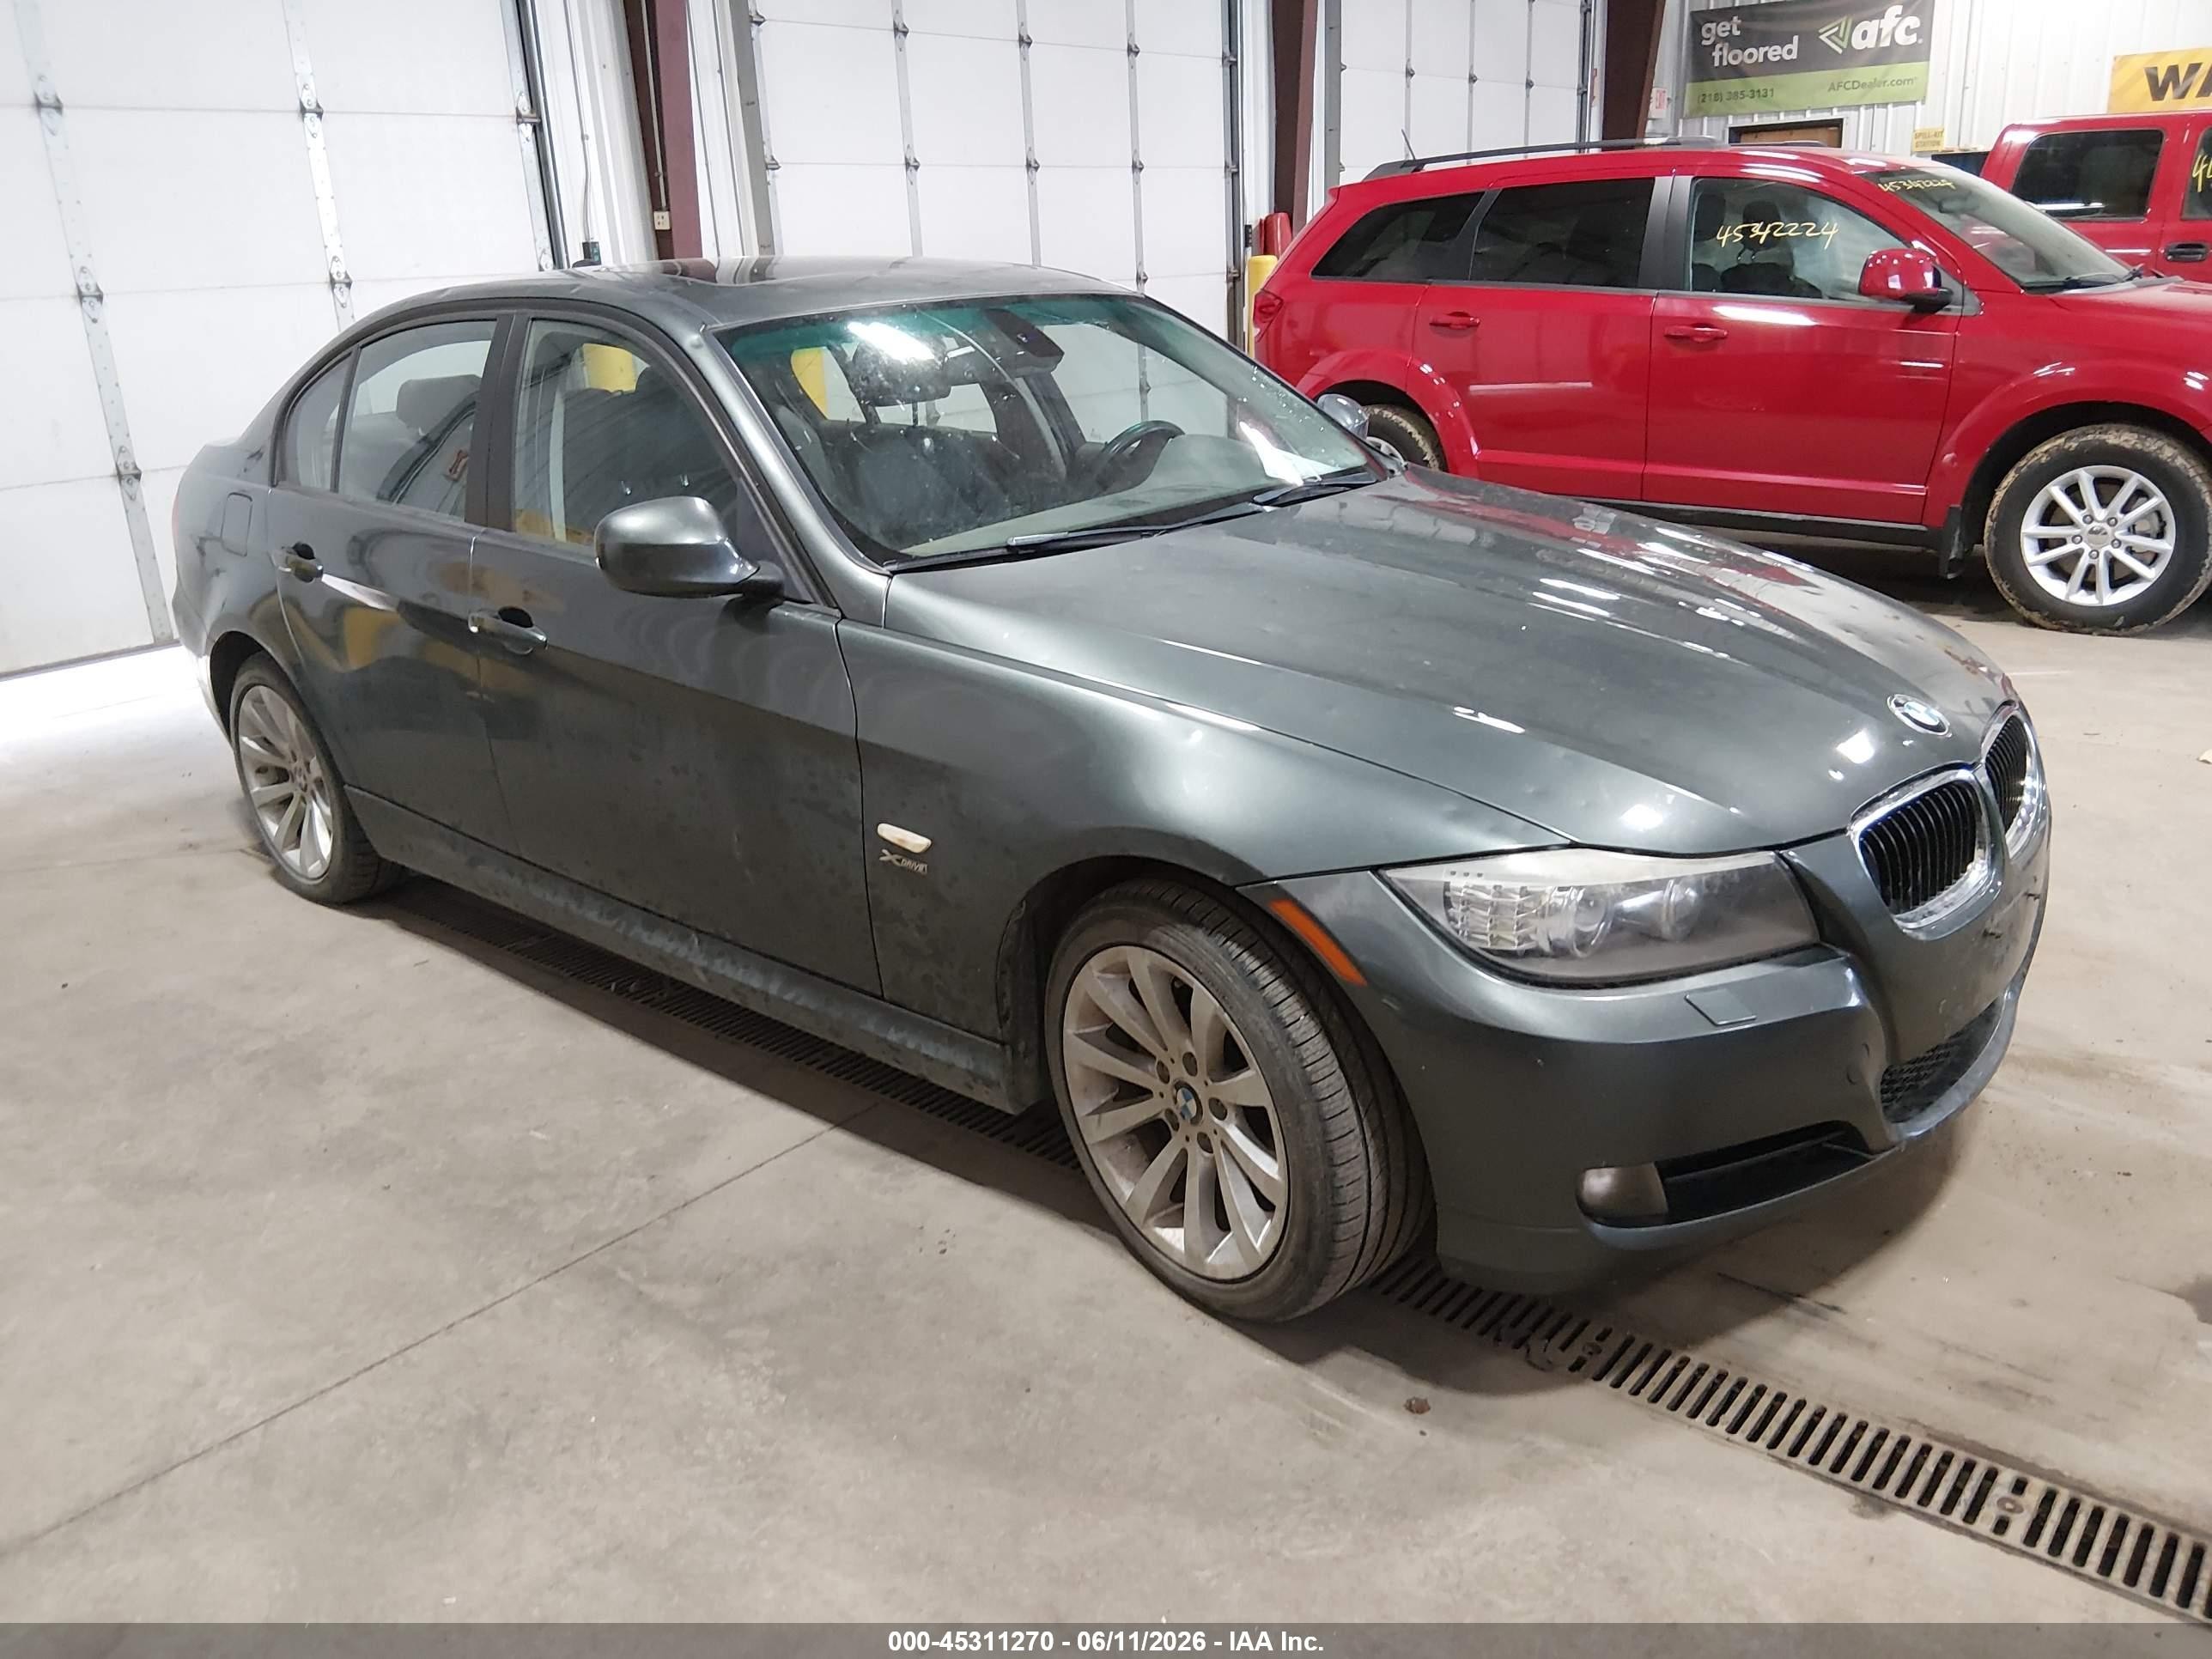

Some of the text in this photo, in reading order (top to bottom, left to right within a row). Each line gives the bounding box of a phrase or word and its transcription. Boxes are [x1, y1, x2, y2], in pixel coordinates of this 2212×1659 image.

[1701, 15, 1741, 45] get
[1851, 5, 1921, 50] afc
[1711, 35, 1799, 67] floored
[1827, 77, 1915, 92] AFCDealer.com
[1716, 221, 1839, 250] 45342224
